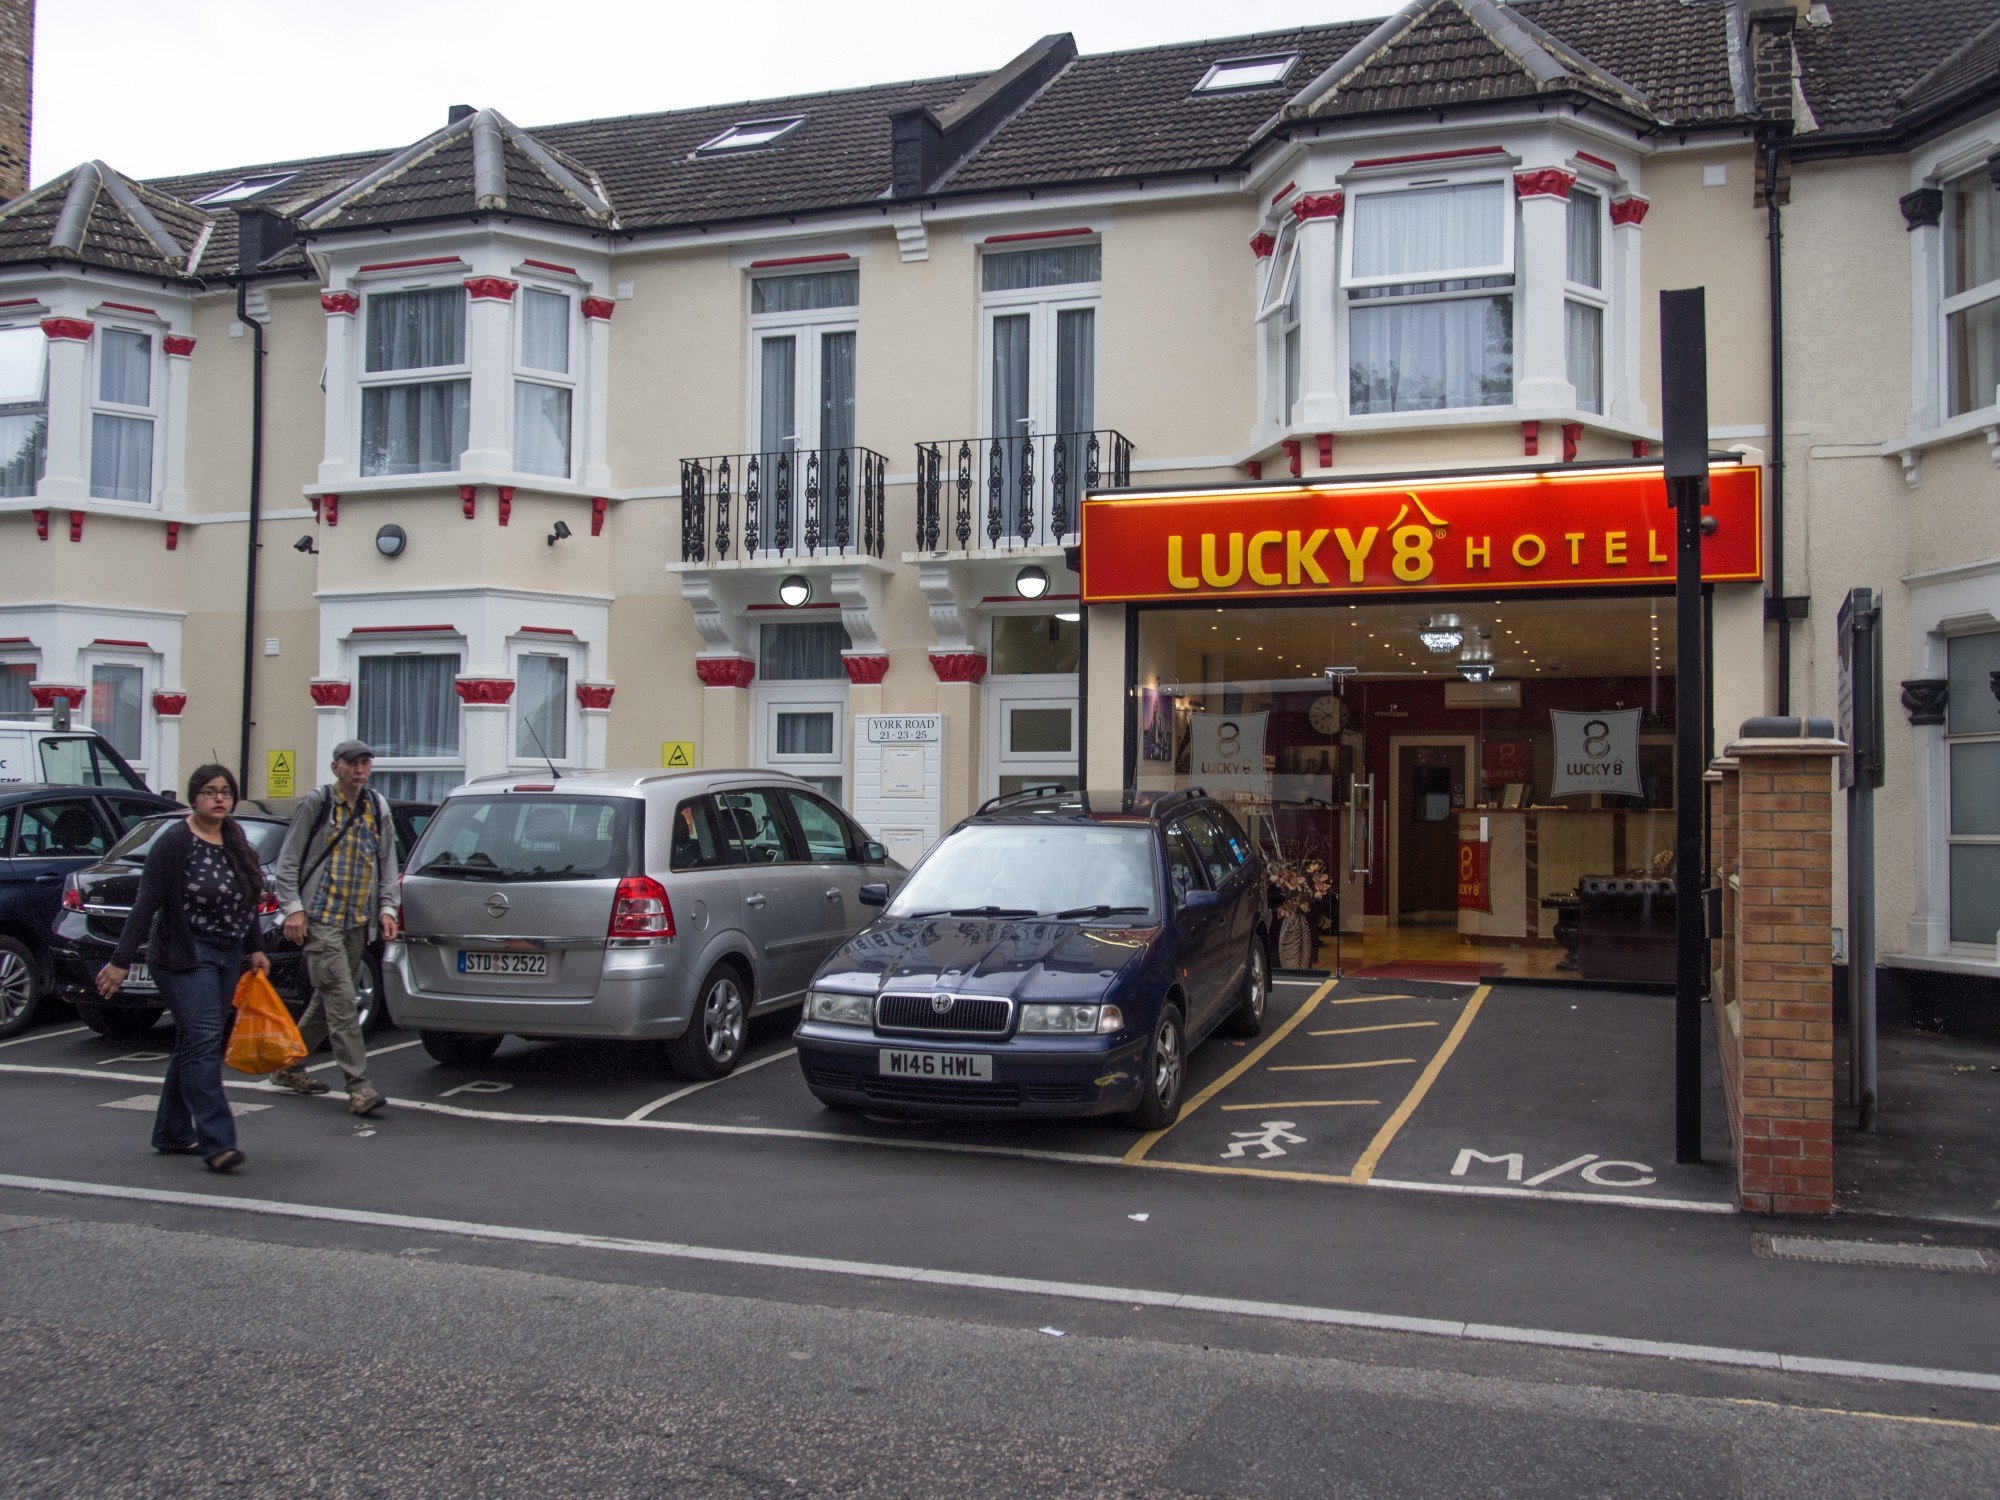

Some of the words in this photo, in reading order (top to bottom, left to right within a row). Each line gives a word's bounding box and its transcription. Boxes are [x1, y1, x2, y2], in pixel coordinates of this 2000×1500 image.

[1168, 526, 1379, 590] LUCKY
[1392, 525, 1434, 582] 8
[1466, 529, 1668, 569] HOTEL
[873, 720, 902, 729] YORK
[905, 719, 935, 729] ROAD
[1201, 762, 1240, 774] LUCKY
[1566, 763, 1611, 776] LUCKY
[1613, 763, 1623, 776] 8
[467, 953, 491, 970] STD
[512, 955, 545, 973] 2522
[890, 1053, 935, 1074] W146
[941, 1056, 982, 1077] HWL
[1450, 1148, 1657, 1187] M/C
